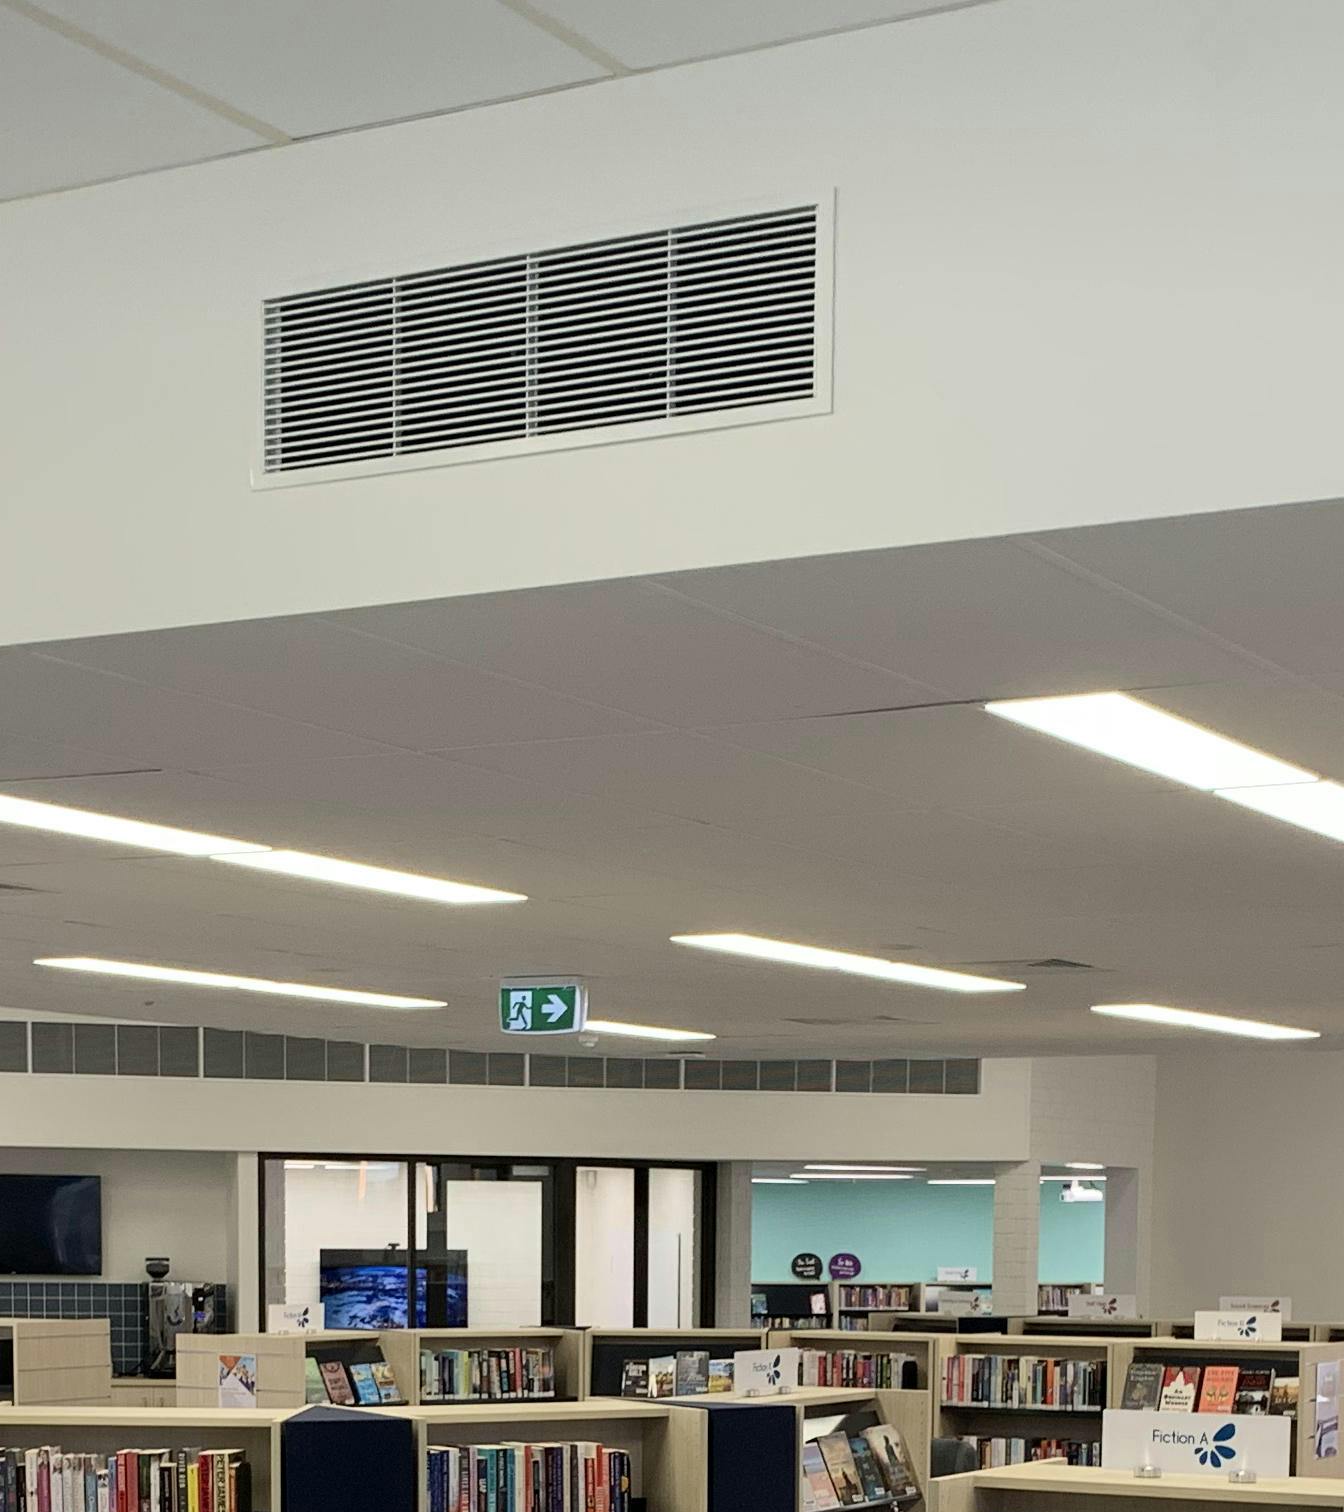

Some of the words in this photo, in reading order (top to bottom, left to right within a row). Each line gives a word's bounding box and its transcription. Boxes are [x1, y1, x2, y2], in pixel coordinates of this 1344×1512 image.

[1152, 1429, 1195, 1445] Fiction
[1199, 1432, 1209, 1445] A
[216, 1454, 225, 1483] PETER
